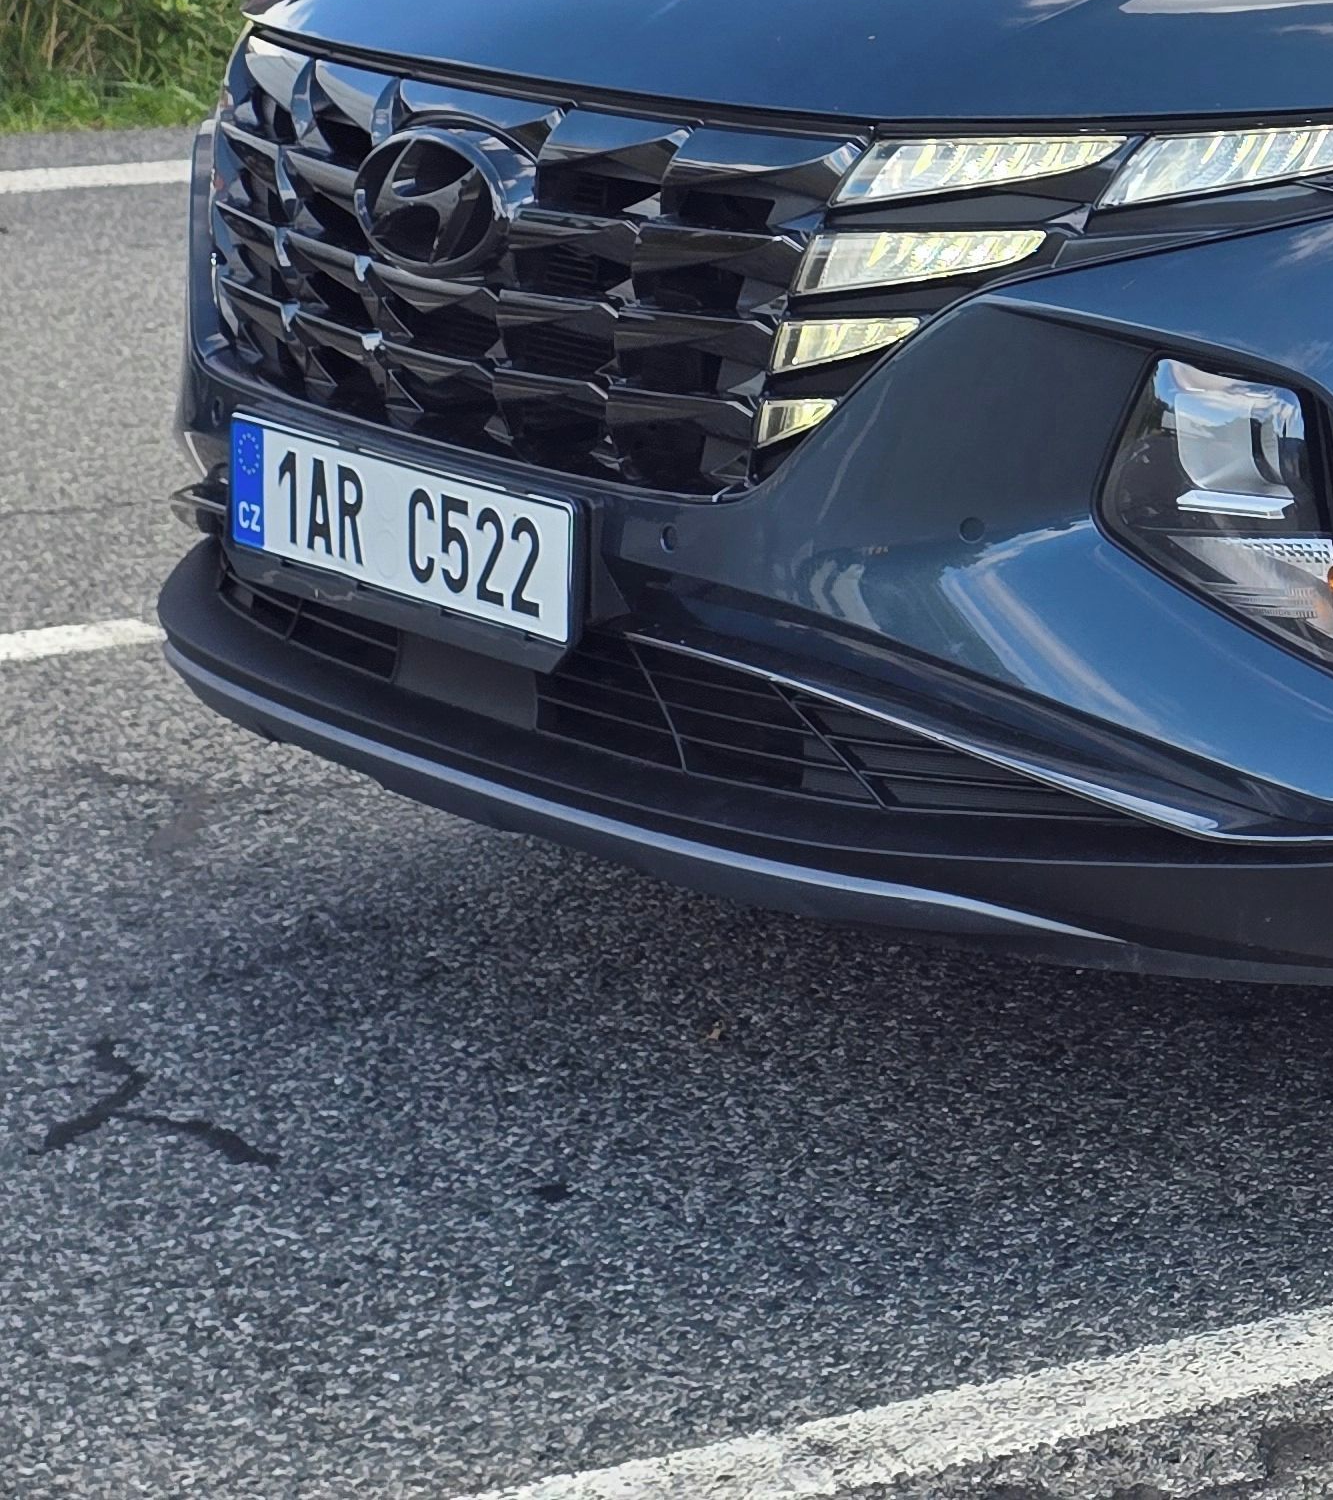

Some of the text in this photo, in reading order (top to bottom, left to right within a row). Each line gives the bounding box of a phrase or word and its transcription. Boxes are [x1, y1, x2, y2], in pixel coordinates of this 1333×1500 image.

[238, 501, 261, 533] CZ
[278, 450, 541, 620] 1AR C522
